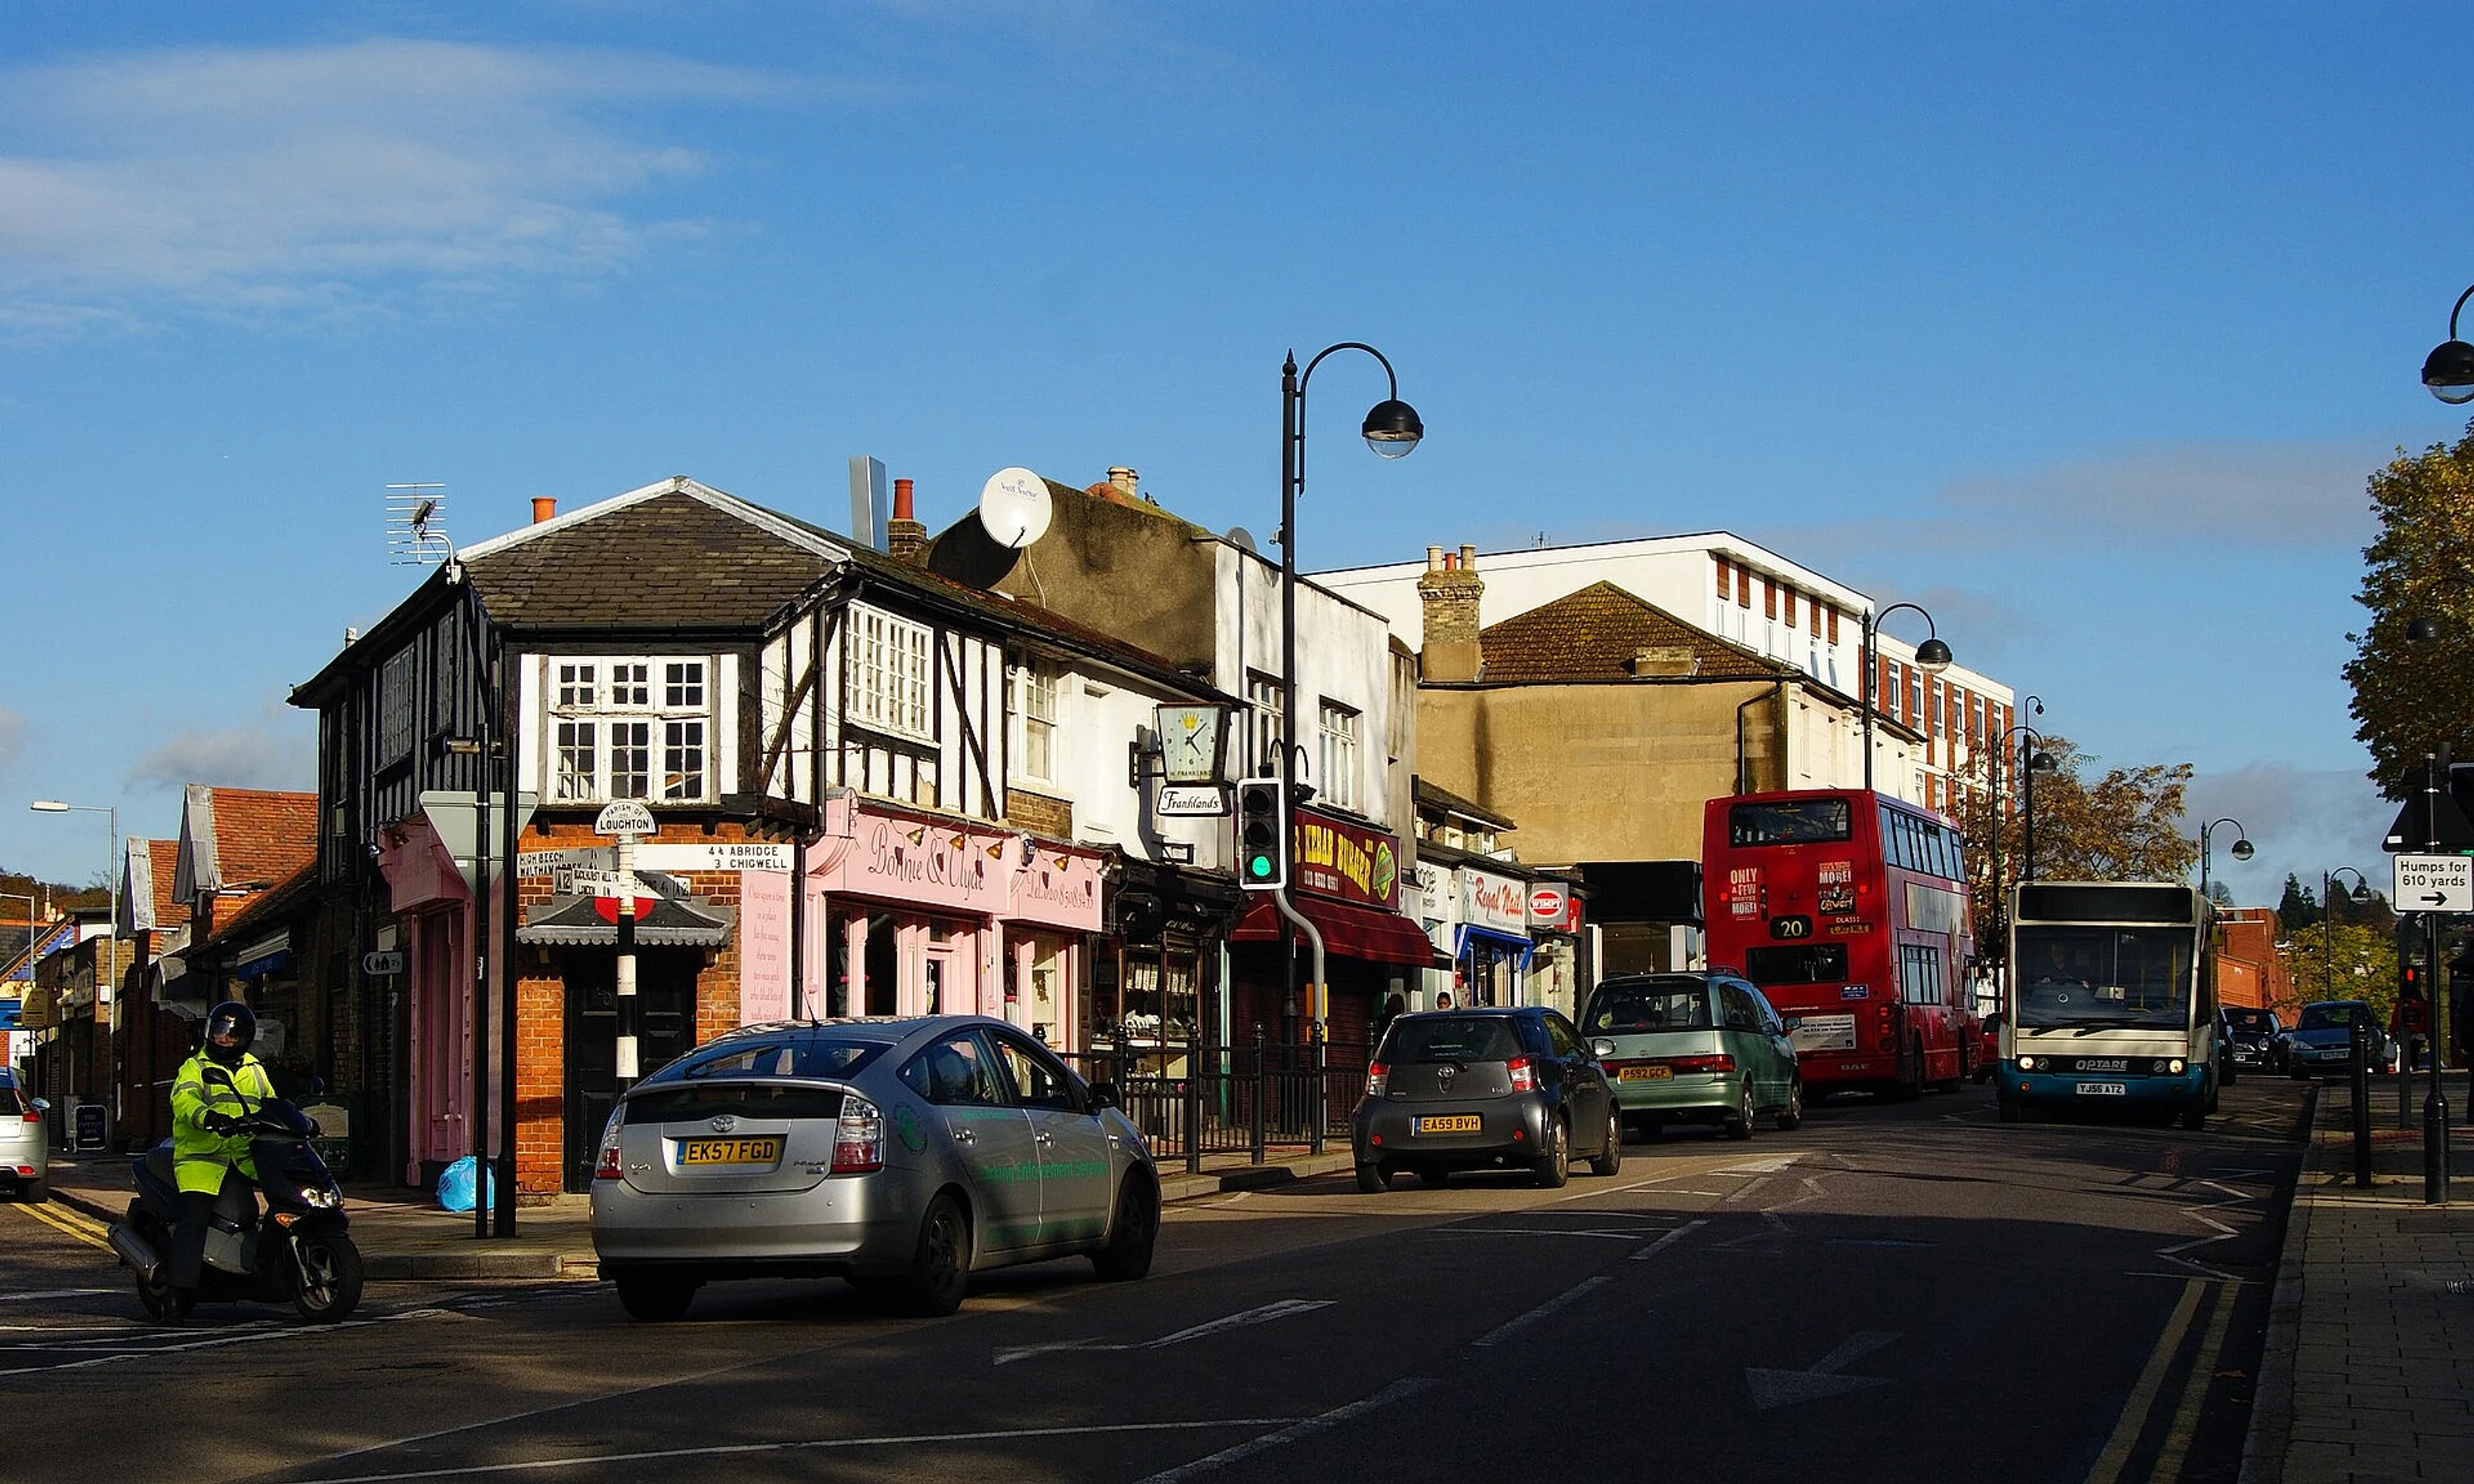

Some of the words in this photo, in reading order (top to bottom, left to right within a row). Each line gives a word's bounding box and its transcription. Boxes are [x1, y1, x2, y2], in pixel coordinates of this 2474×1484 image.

[1162, 791, 1220, 811] Franklands
[606, 804, 631, 818] PARISH
[634, 805, 644, 817] OF
[539, 851, 564, 864] BEECH
[730, 846, 778, 857] ABRIDGE
[714, 859, 721, 869] 3
[730, 859, 787, 869] CHIGWELL
[1305, 824, 1333, 867] KEBAB
[1337, 833, 1371, 896] BURGER
[2400, 861, 2445, 873] Humps
[2449, 861, 2467, 872] for
[1730, 868, 1758, 884] ONLY
[1819, 870, 1852, 884] MORE!
[2402, 875, 2426, 886] 610
[2430, 875, 2466, 888] yards
[1738, 883, 1756, 897] FEW
[1731, 902, 1758, 915] MORE!
[1780, 920, 1803, 937] 20
[2075, 1060, 2128, 1070] OPTARE
[1623, 1069, 1647, 1079] P592
[1649, 1067, 1667, 1078] GCF
[2104, 1085, 2122, 1094] ATZ
[1423, 1119, 1453, 1130] EA59
[1455, 1118, 1479, 1130] BVH
[687, 1142, 734, 1161] EK57
[738, 1141, 774, 1160] FGD
